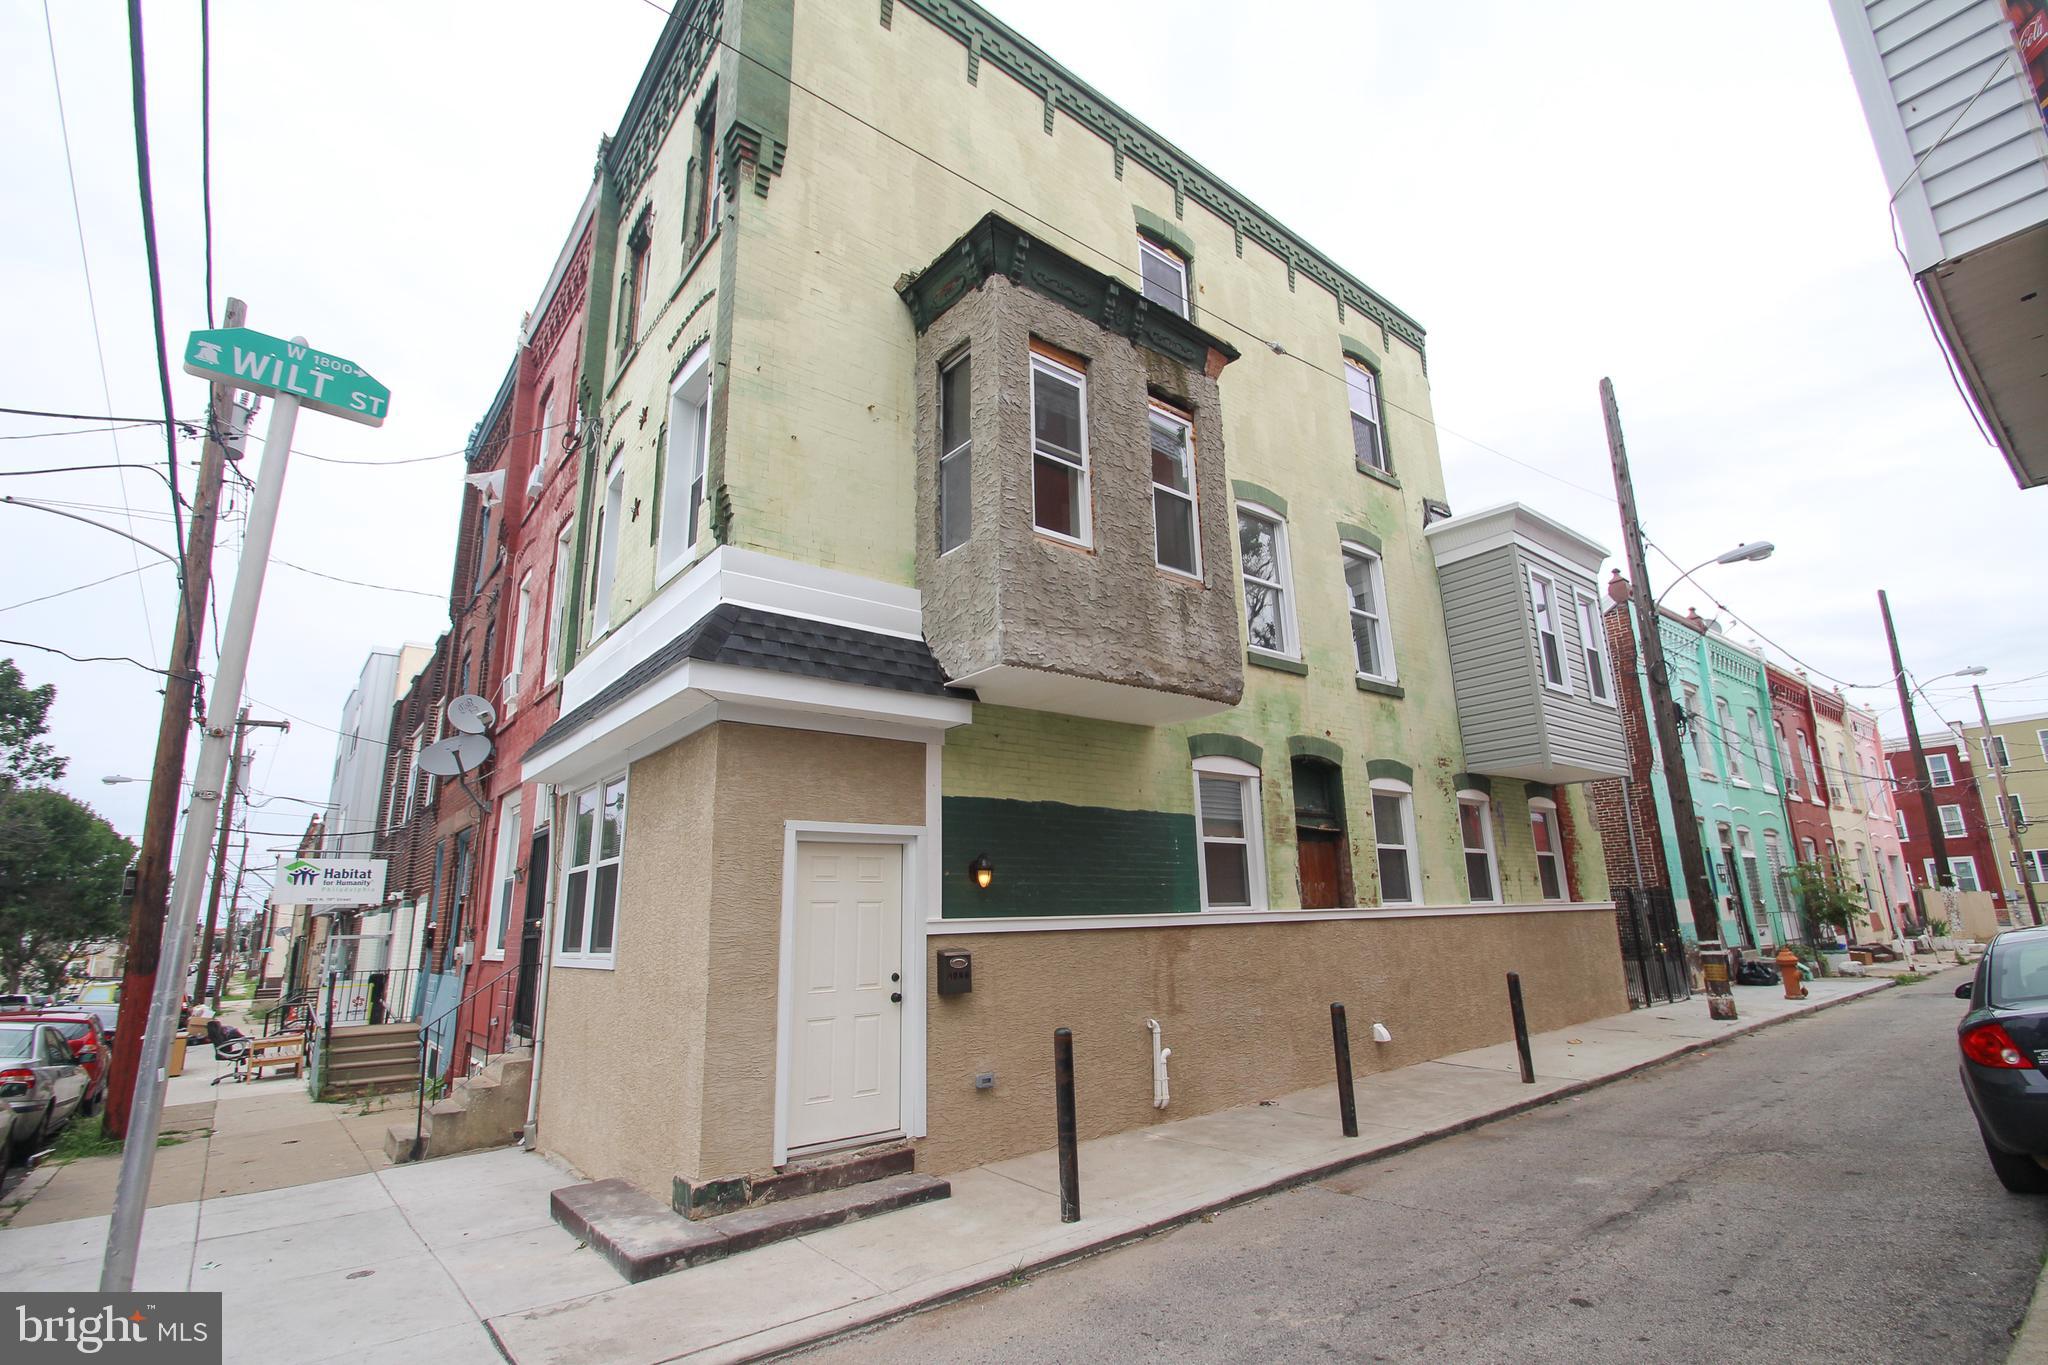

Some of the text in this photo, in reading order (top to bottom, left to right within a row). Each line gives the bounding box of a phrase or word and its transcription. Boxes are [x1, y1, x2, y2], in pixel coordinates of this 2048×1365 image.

[287, 343, 353, 375] W 1800
[233, 346, 385, 415] WILT ST
[324, 868, 372, 879] Habitat
[336, 879, 370, 887] Humanity
